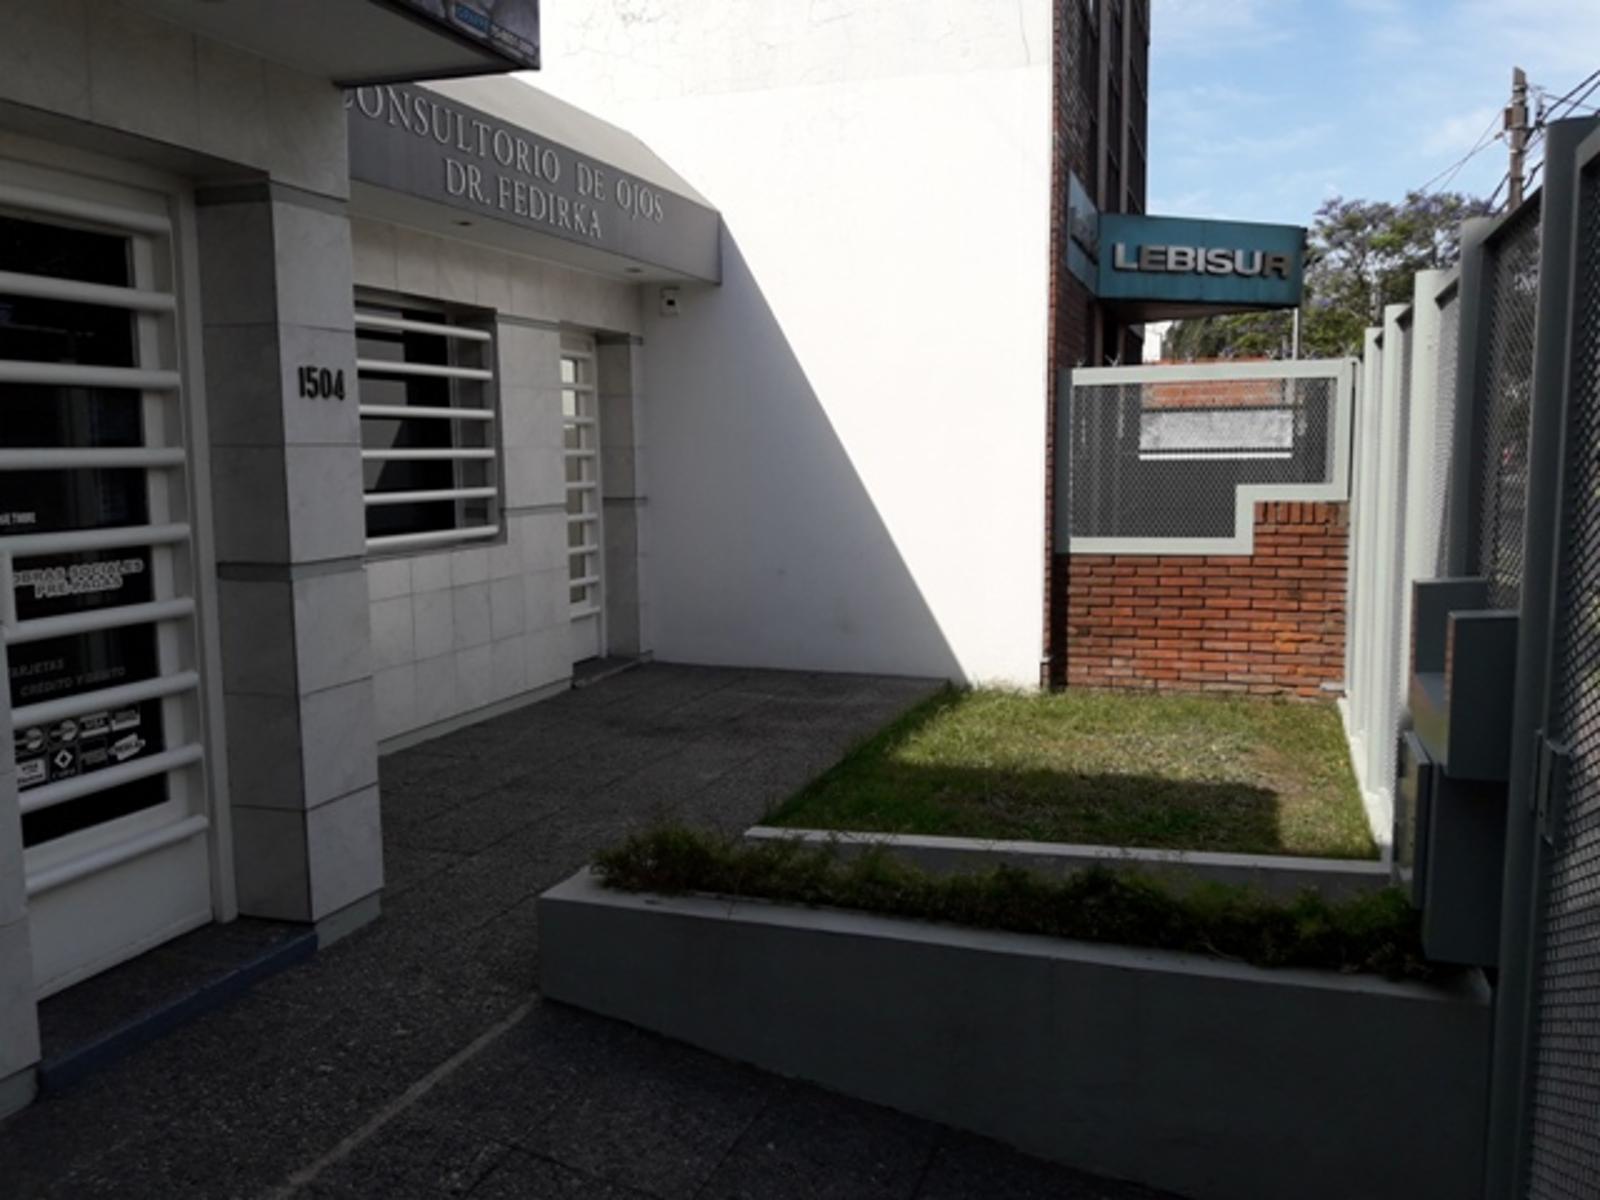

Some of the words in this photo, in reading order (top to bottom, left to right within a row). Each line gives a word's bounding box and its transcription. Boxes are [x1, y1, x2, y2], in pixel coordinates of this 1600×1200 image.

[445, 158, 491, 205] DR.
[498, 176, 601, 238] FEDIRKA
[577, 162, 604, 200] DE
[616, 179, 664, 222] OJOS
[1113, 242, 1291, 278] LEBISUR
[298, 366, 345, 400] 1504
